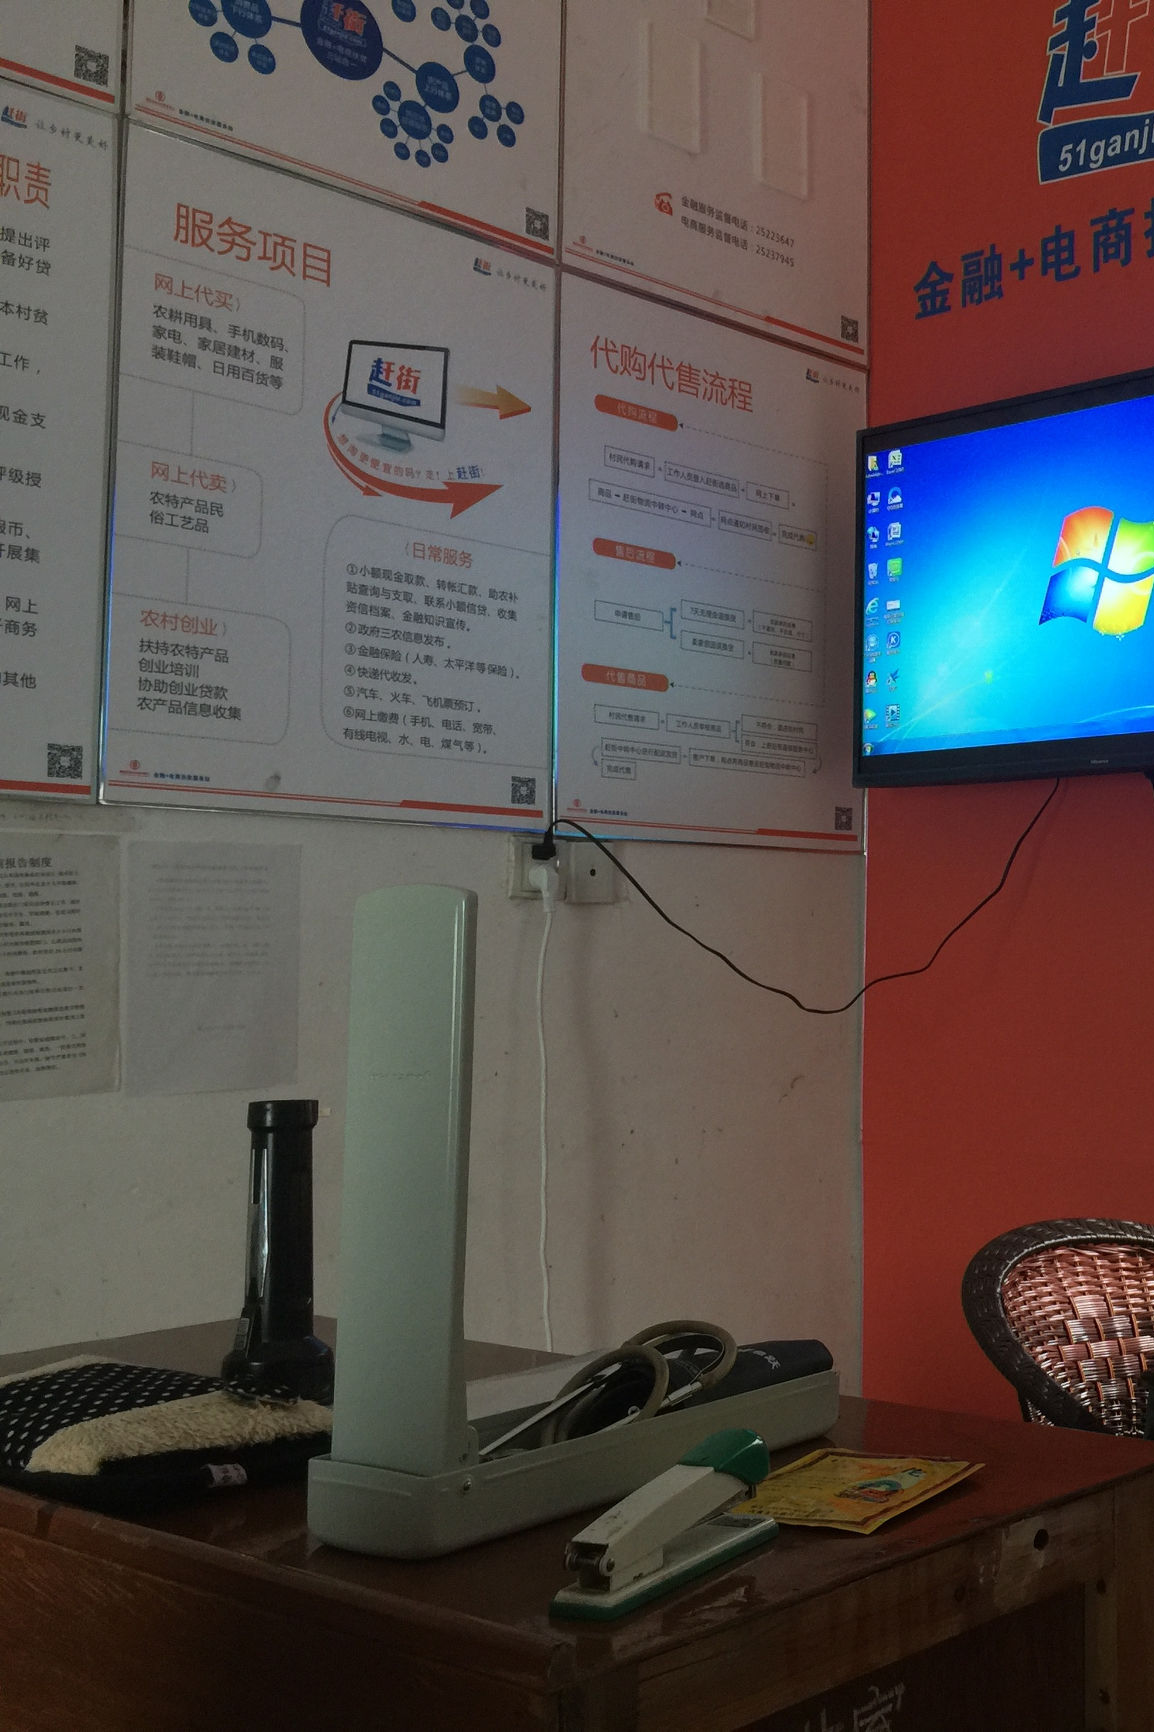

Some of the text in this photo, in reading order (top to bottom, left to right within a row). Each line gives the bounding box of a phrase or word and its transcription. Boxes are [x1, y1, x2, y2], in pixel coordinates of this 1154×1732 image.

[173, 202, 332, 288] 服务项目
[0, 301, 49, 326] 本村贫
[590, 335, 754, 413] 代购代售流程
[0, 465, 42, 488] 级授
[149, 489, 224, 518] 农特产品民
[149, 510, 209, 534] 俗工艺品
[412, 541, 473, 569] 日常服务
[0, 617, 38, 638] 商务
[140, 609, 218, 637] 农村创业
[138, 638, 230, 664] 扶持农特产品
[0, 670, 37, 690] 其他
[138, 656, 200, 679] 创业培训
[137, 676, 229, 701] 协助创业贷款
[136, 696, 242, 722] 农产品信息收集
